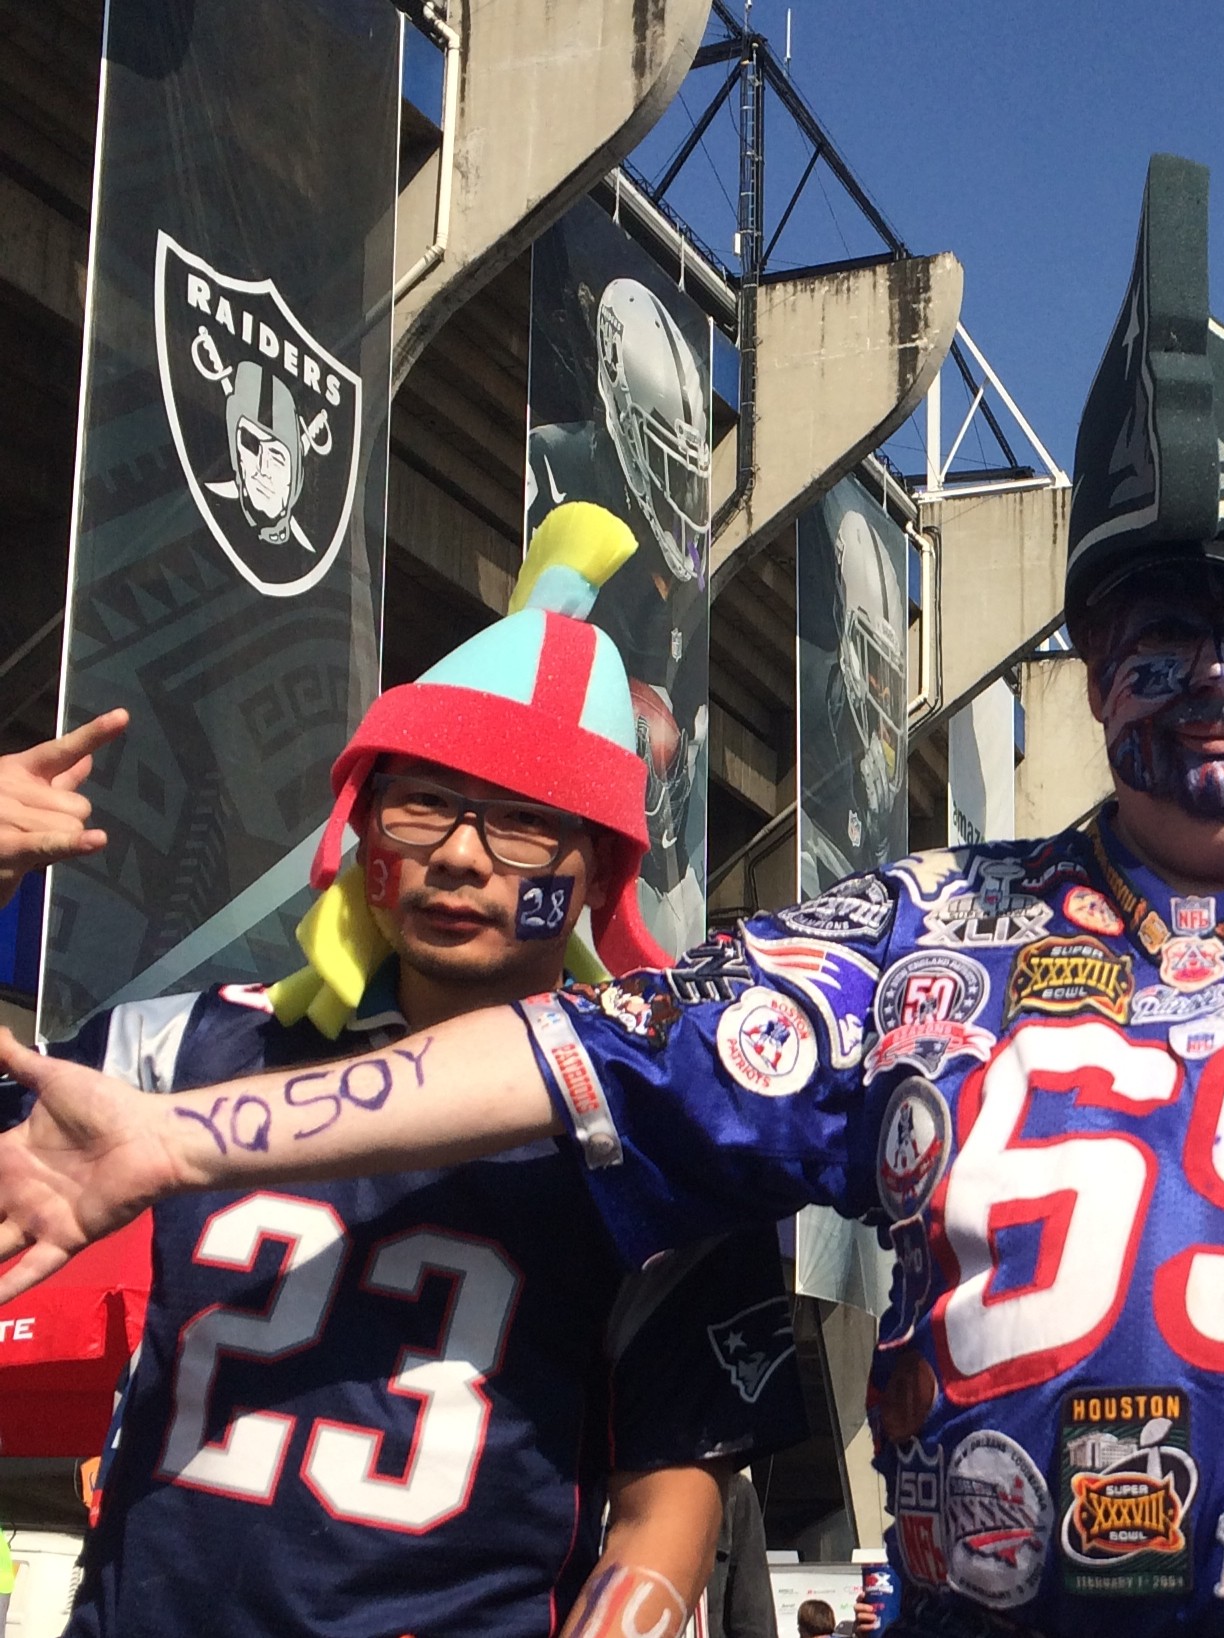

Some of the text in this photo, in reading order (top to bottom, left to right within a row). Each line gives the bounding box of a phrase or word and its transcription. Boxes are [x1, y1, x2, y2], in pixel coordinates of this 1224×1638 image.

[186, 272, 341, 407] RAIDERS
[371, 858, 389, 901] 3
[521, 887, 565, 928] 28
[918, 908, 1053, 943] XLIX
[1178, 910, 1210, 930] NFL
[1050, 945, 1104, 959] SUPER
[1021, 957, 1121, 998] XXXVIII
[1041, 986, 1088, 999] BOWL
[771, 999, 810, 1040] BOSTON
[901, 976, 958, 1026] 50
[551, 1043, 600, 1115] PATRIOTS
[727, 1038, 771, 1088] PATRIOTS
[176, 1036, 435, 1155] YO SOY
[153, 1190, 525, 1536] 23
[1072, 1394, 1181, 1421] HOUSTON
[900, 1470, 938, 1508] 50
[1105, 1483, 1149, 1496] SUPER
[1088, 1491, 1167, 1533] XXXVIII
[1108, 1531, 1148, 1541] BOWL
